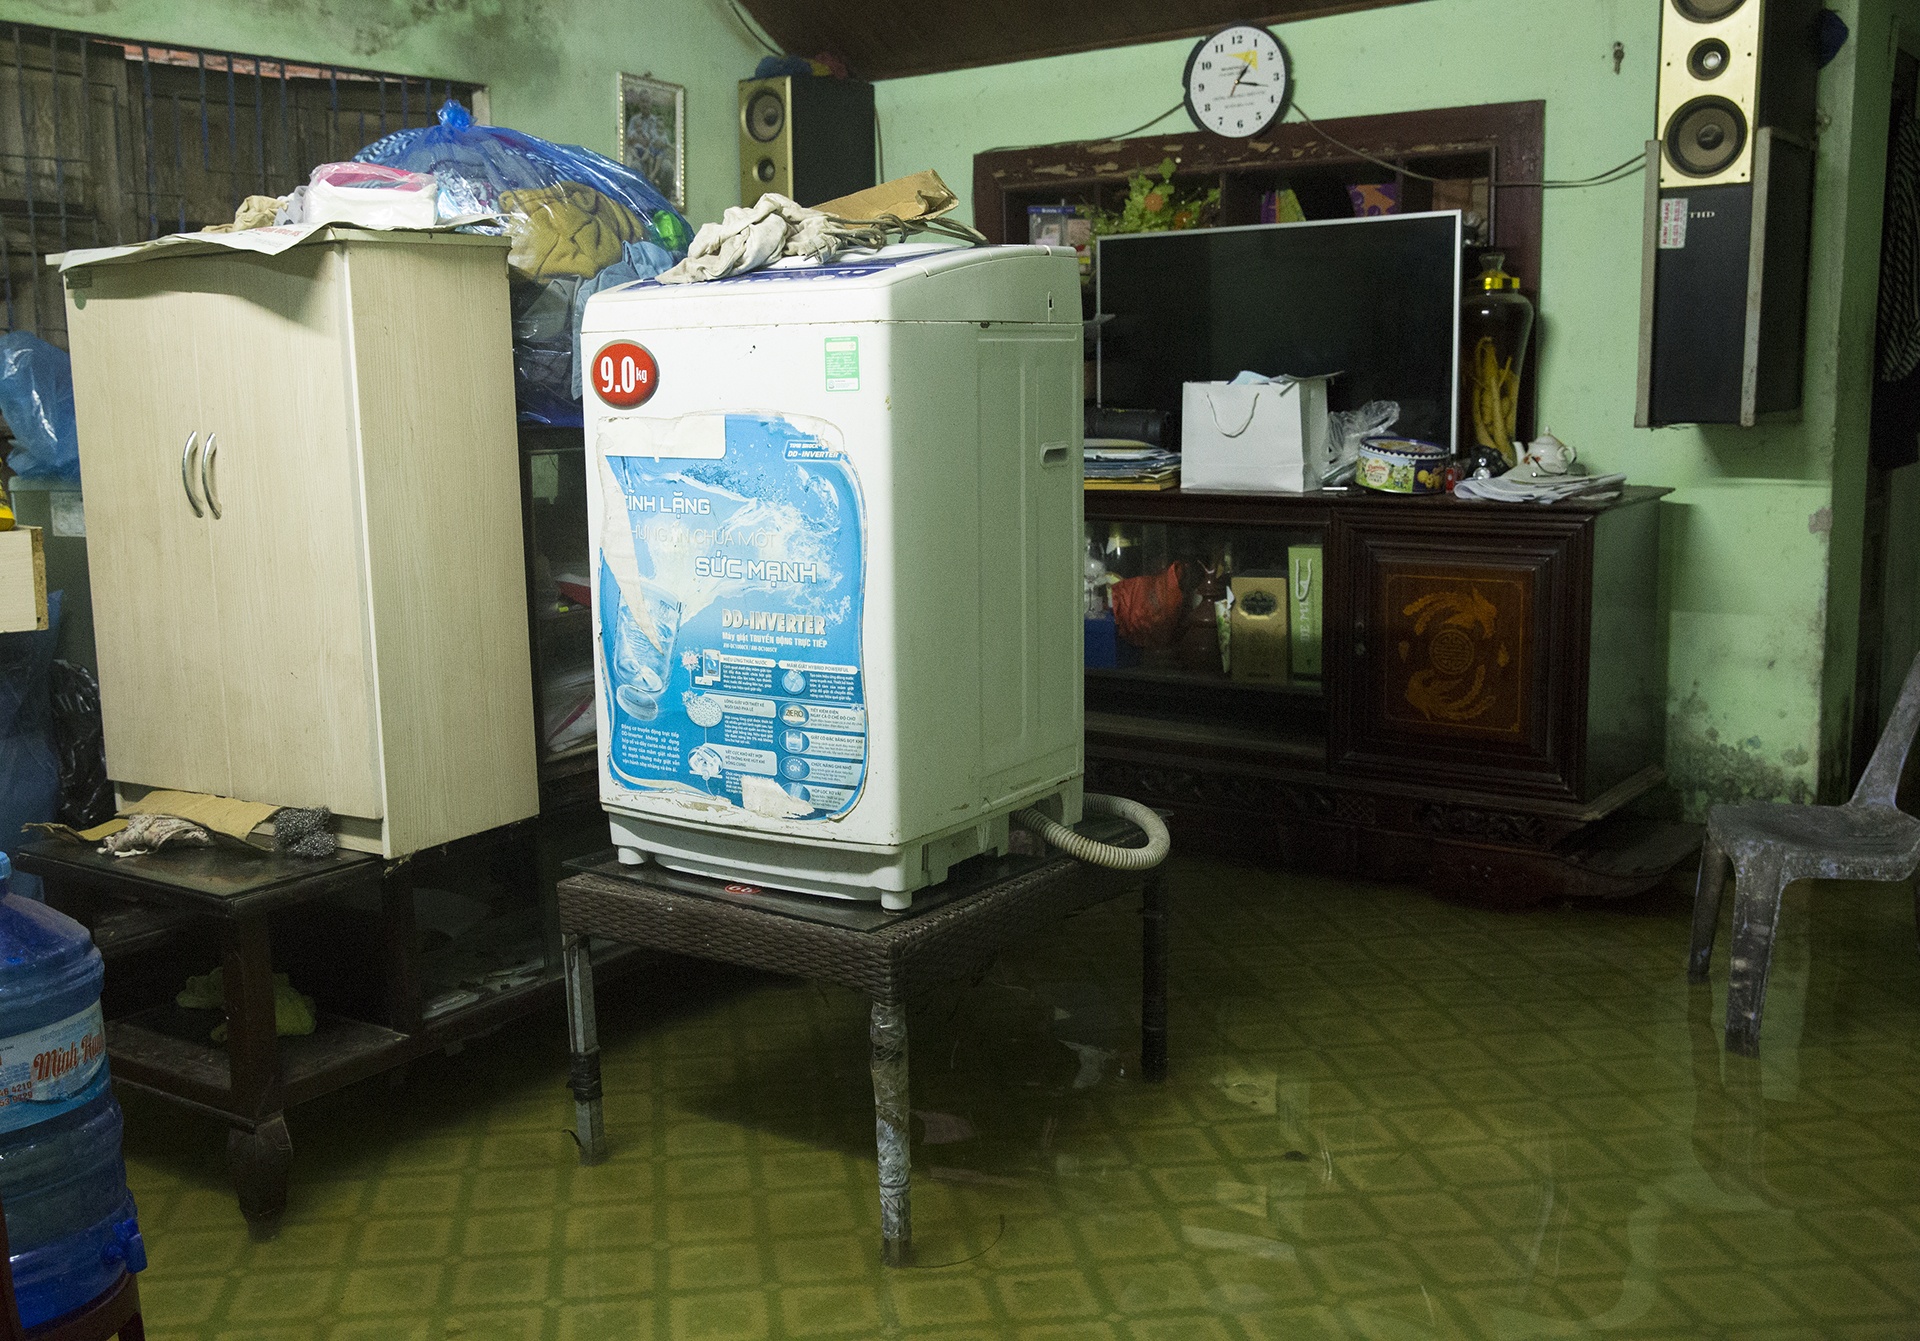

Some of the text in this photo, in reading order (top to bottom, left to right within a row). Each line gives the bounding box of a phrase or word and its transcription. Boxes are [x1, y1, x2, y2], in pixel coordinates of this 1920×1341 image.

[1232, 35, 1243, 44] 12
[1254, 39, 1258, 47] 1
[1215, 44, 1224, 53] 11
[1268, 52, 1274, 60] 2
[1202, 62, 1211, 70] 10
[1274, 73, 1279, 81] 3
[1198, 84, 1204, 92] 9
[1270, 95, 1274, 103] 4
[1205, 104, 1211, 112] 8
[1218, 118, 1223, 126] 7
[1237, 120, 1243, 128] 6
[625, 489, 711, 520] ĨNH LẶNG
[694, 549, 818, 588] SỨC MẠNH
[722, 608, 826, 635] DD-INVERTER
[722, 632, 735, 641] Máy
[785, 708, 803, 718] ZERO
[34, 1041, 78, 1081] Minh
